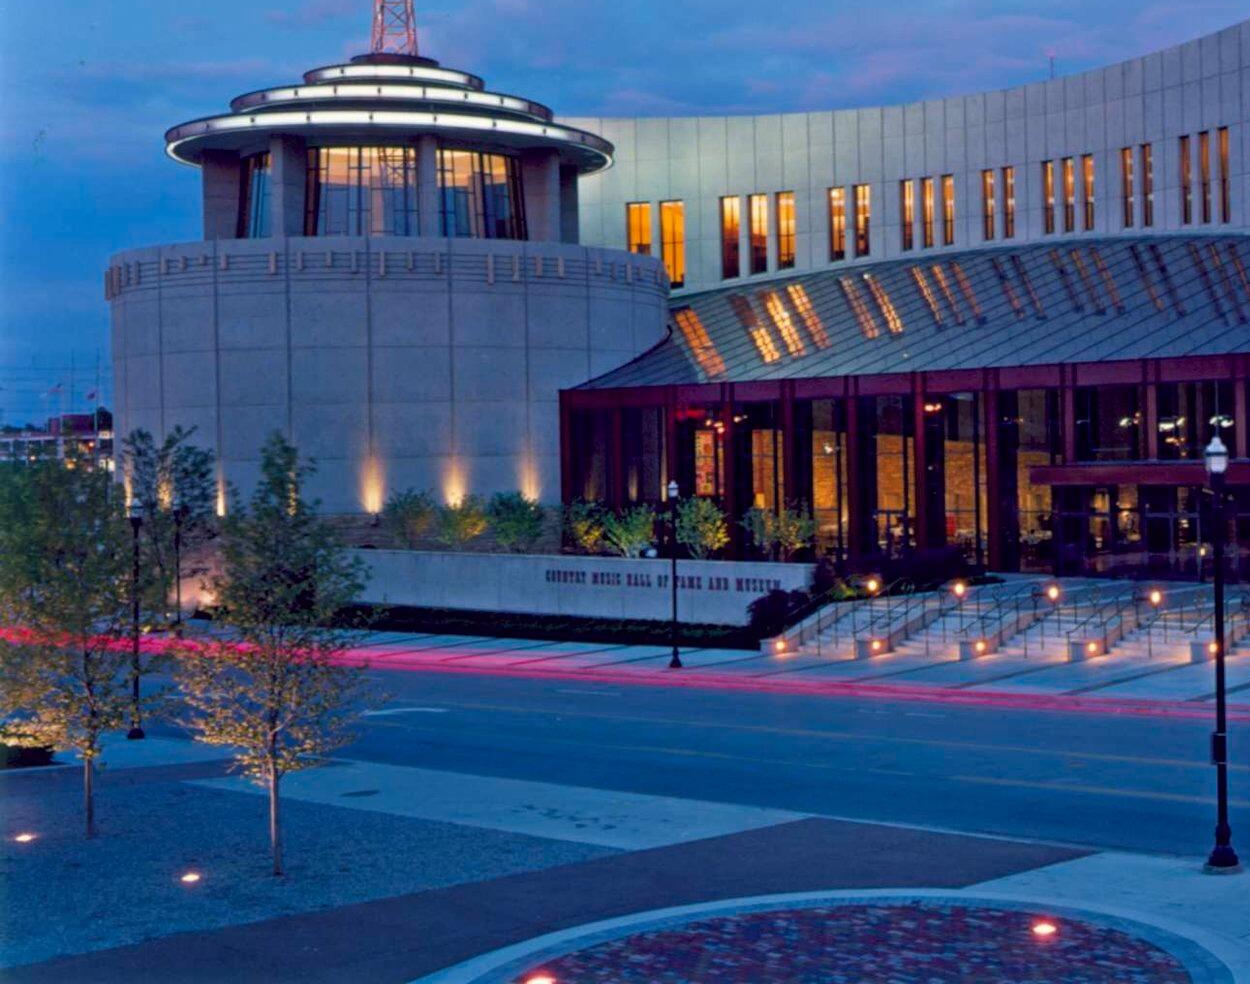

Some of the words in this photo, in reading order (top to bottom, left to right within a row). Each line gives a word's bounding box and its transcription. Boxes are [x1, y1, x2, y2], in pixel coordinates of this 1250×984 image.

[592, 572, 621, 585] MUSIC
[627, 573, 652, 587] HALL
[657, 574, 668, 588] OF
[708, 577, 729, 590] AND
